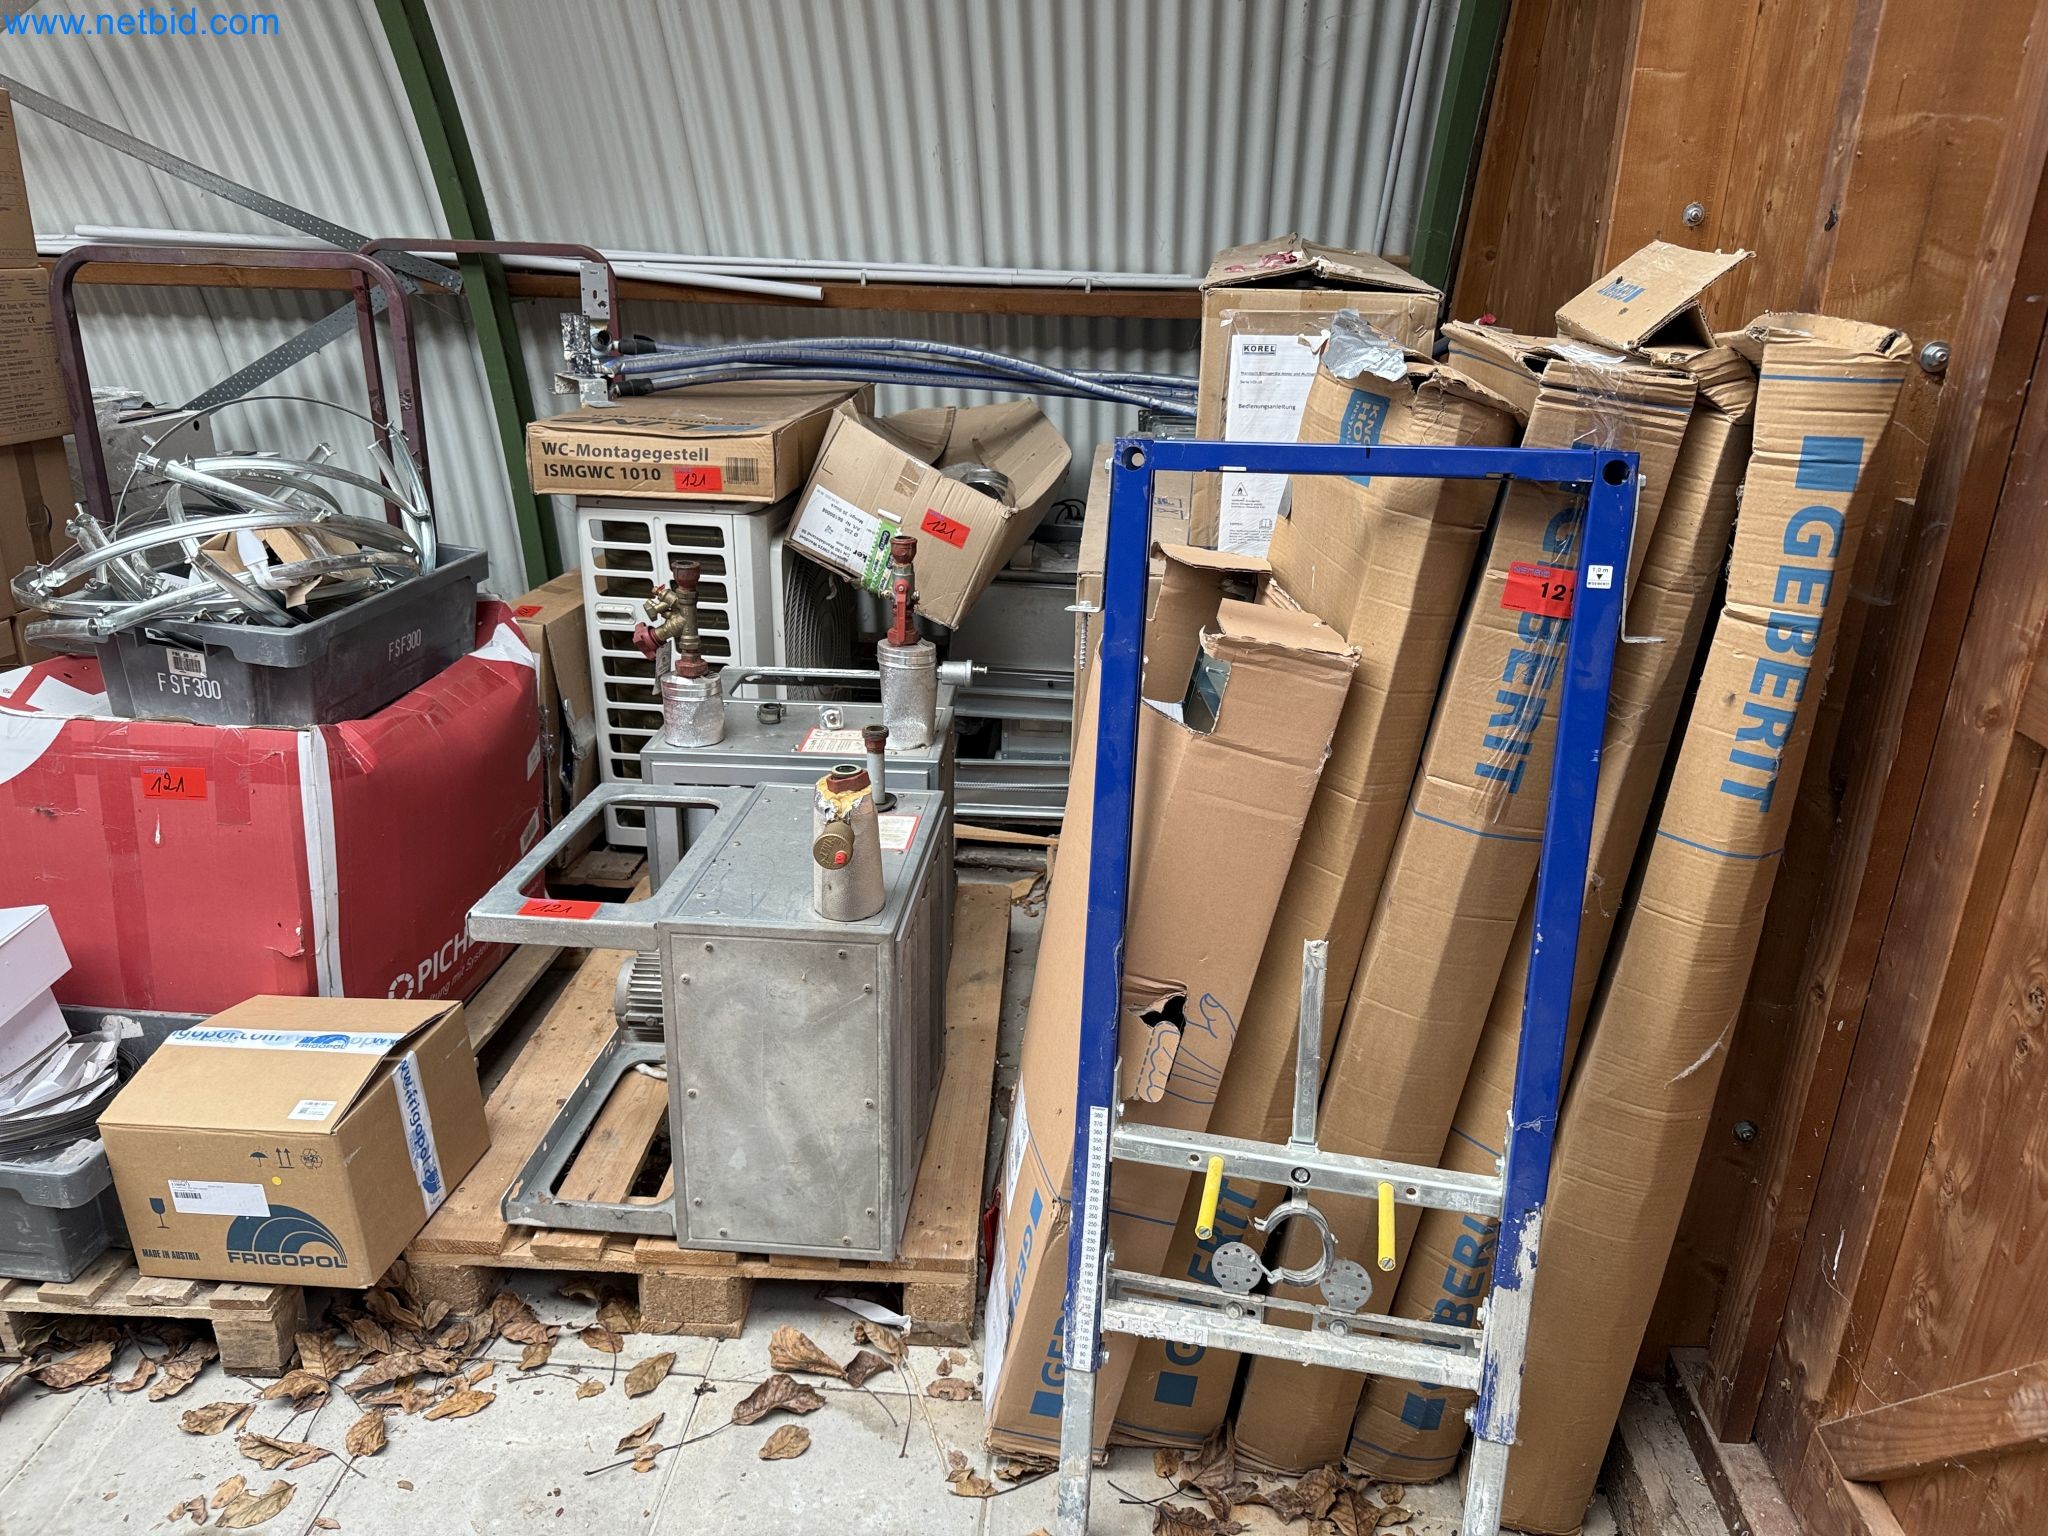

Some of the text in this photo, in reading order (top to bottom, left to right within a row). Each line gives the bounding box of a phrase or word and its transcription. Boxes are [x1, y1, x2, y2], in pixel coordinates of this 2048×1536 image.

[1238, 403, 1296, 411] Bedienungsanleitung
[541, 441, 710, 462] WC-Montagegestell
[543, 463, 615, 480] ISMGWC
[621, 467, 662, 482] 1010
[680, 474, 706, 488] 121
[852, 549, 868, 563] ker
[389, 628, 421, 662] FSF300
[1474, 505, 1585, 795] GBERIT
[1720, 505, 1846, 813] GEBERIT
[157, 672, 222, 699] FSF300
[150, 772, 185, 793] 121
[532, 904, 573, 913] 121
[142, 1249, 200, 1261] MADE IN AUSTRIA
[227, 1251, 348, 1269] FRIGOPOL
